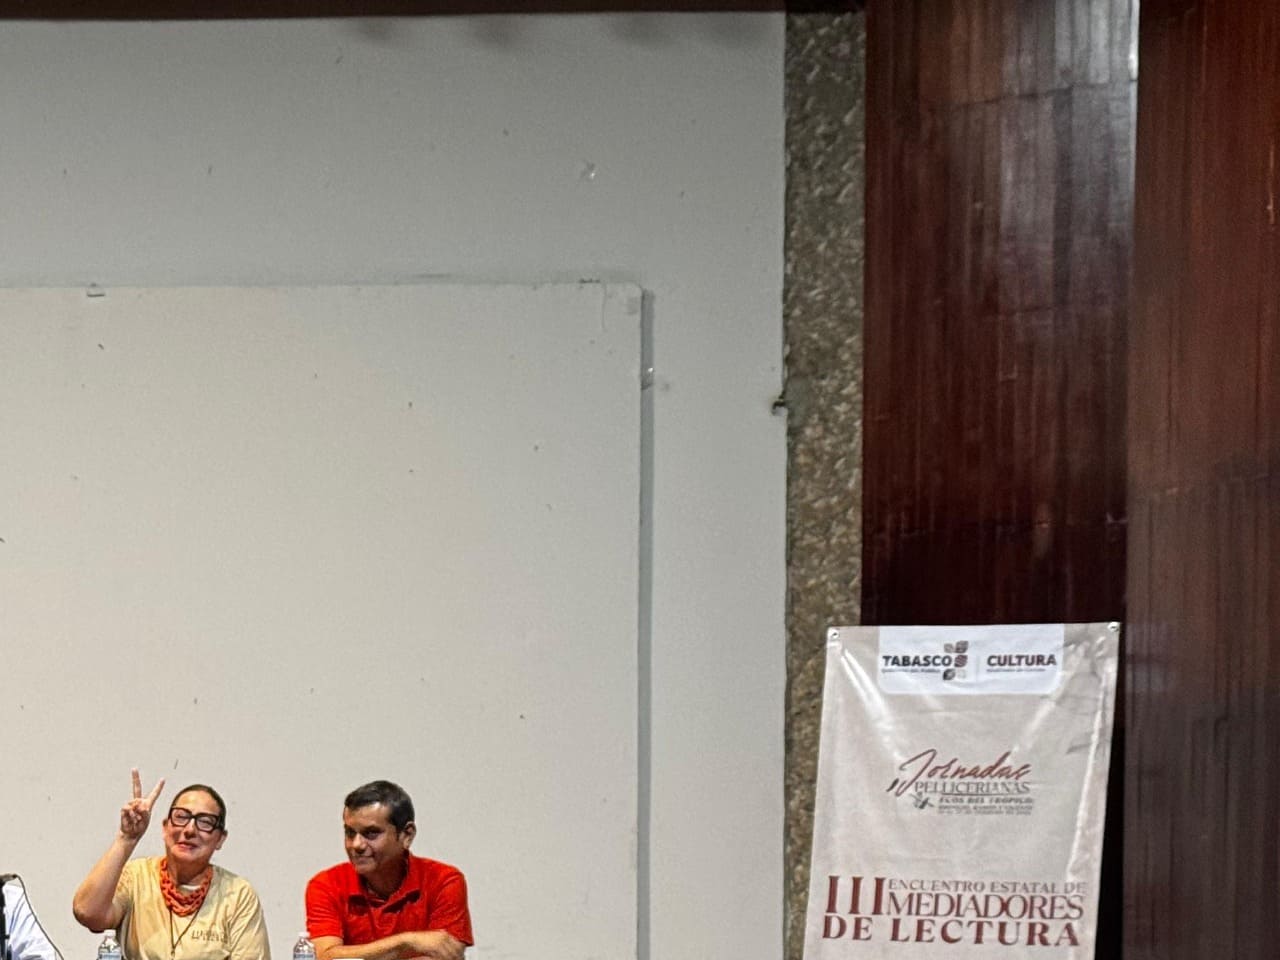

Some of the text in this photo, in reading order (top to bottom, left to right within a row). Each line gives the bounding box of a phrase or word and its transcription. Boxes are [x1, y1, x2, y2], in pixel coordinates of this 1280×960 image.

[882, 655, 952, 667] TABASCO
[986, 654, 1057, 667] CULTURA
[915, 781, 1031, 793] PELLICERIANAS
[888, 878, 986, 893] ENCUENTRO
[990, 880, 1060, 894] ESTATAL
[1063, 881, 1088, 894] DE
[887, 891, 1084, 920] MEDIADORES
[822, 914, 1080, 947] DE LECTURA
